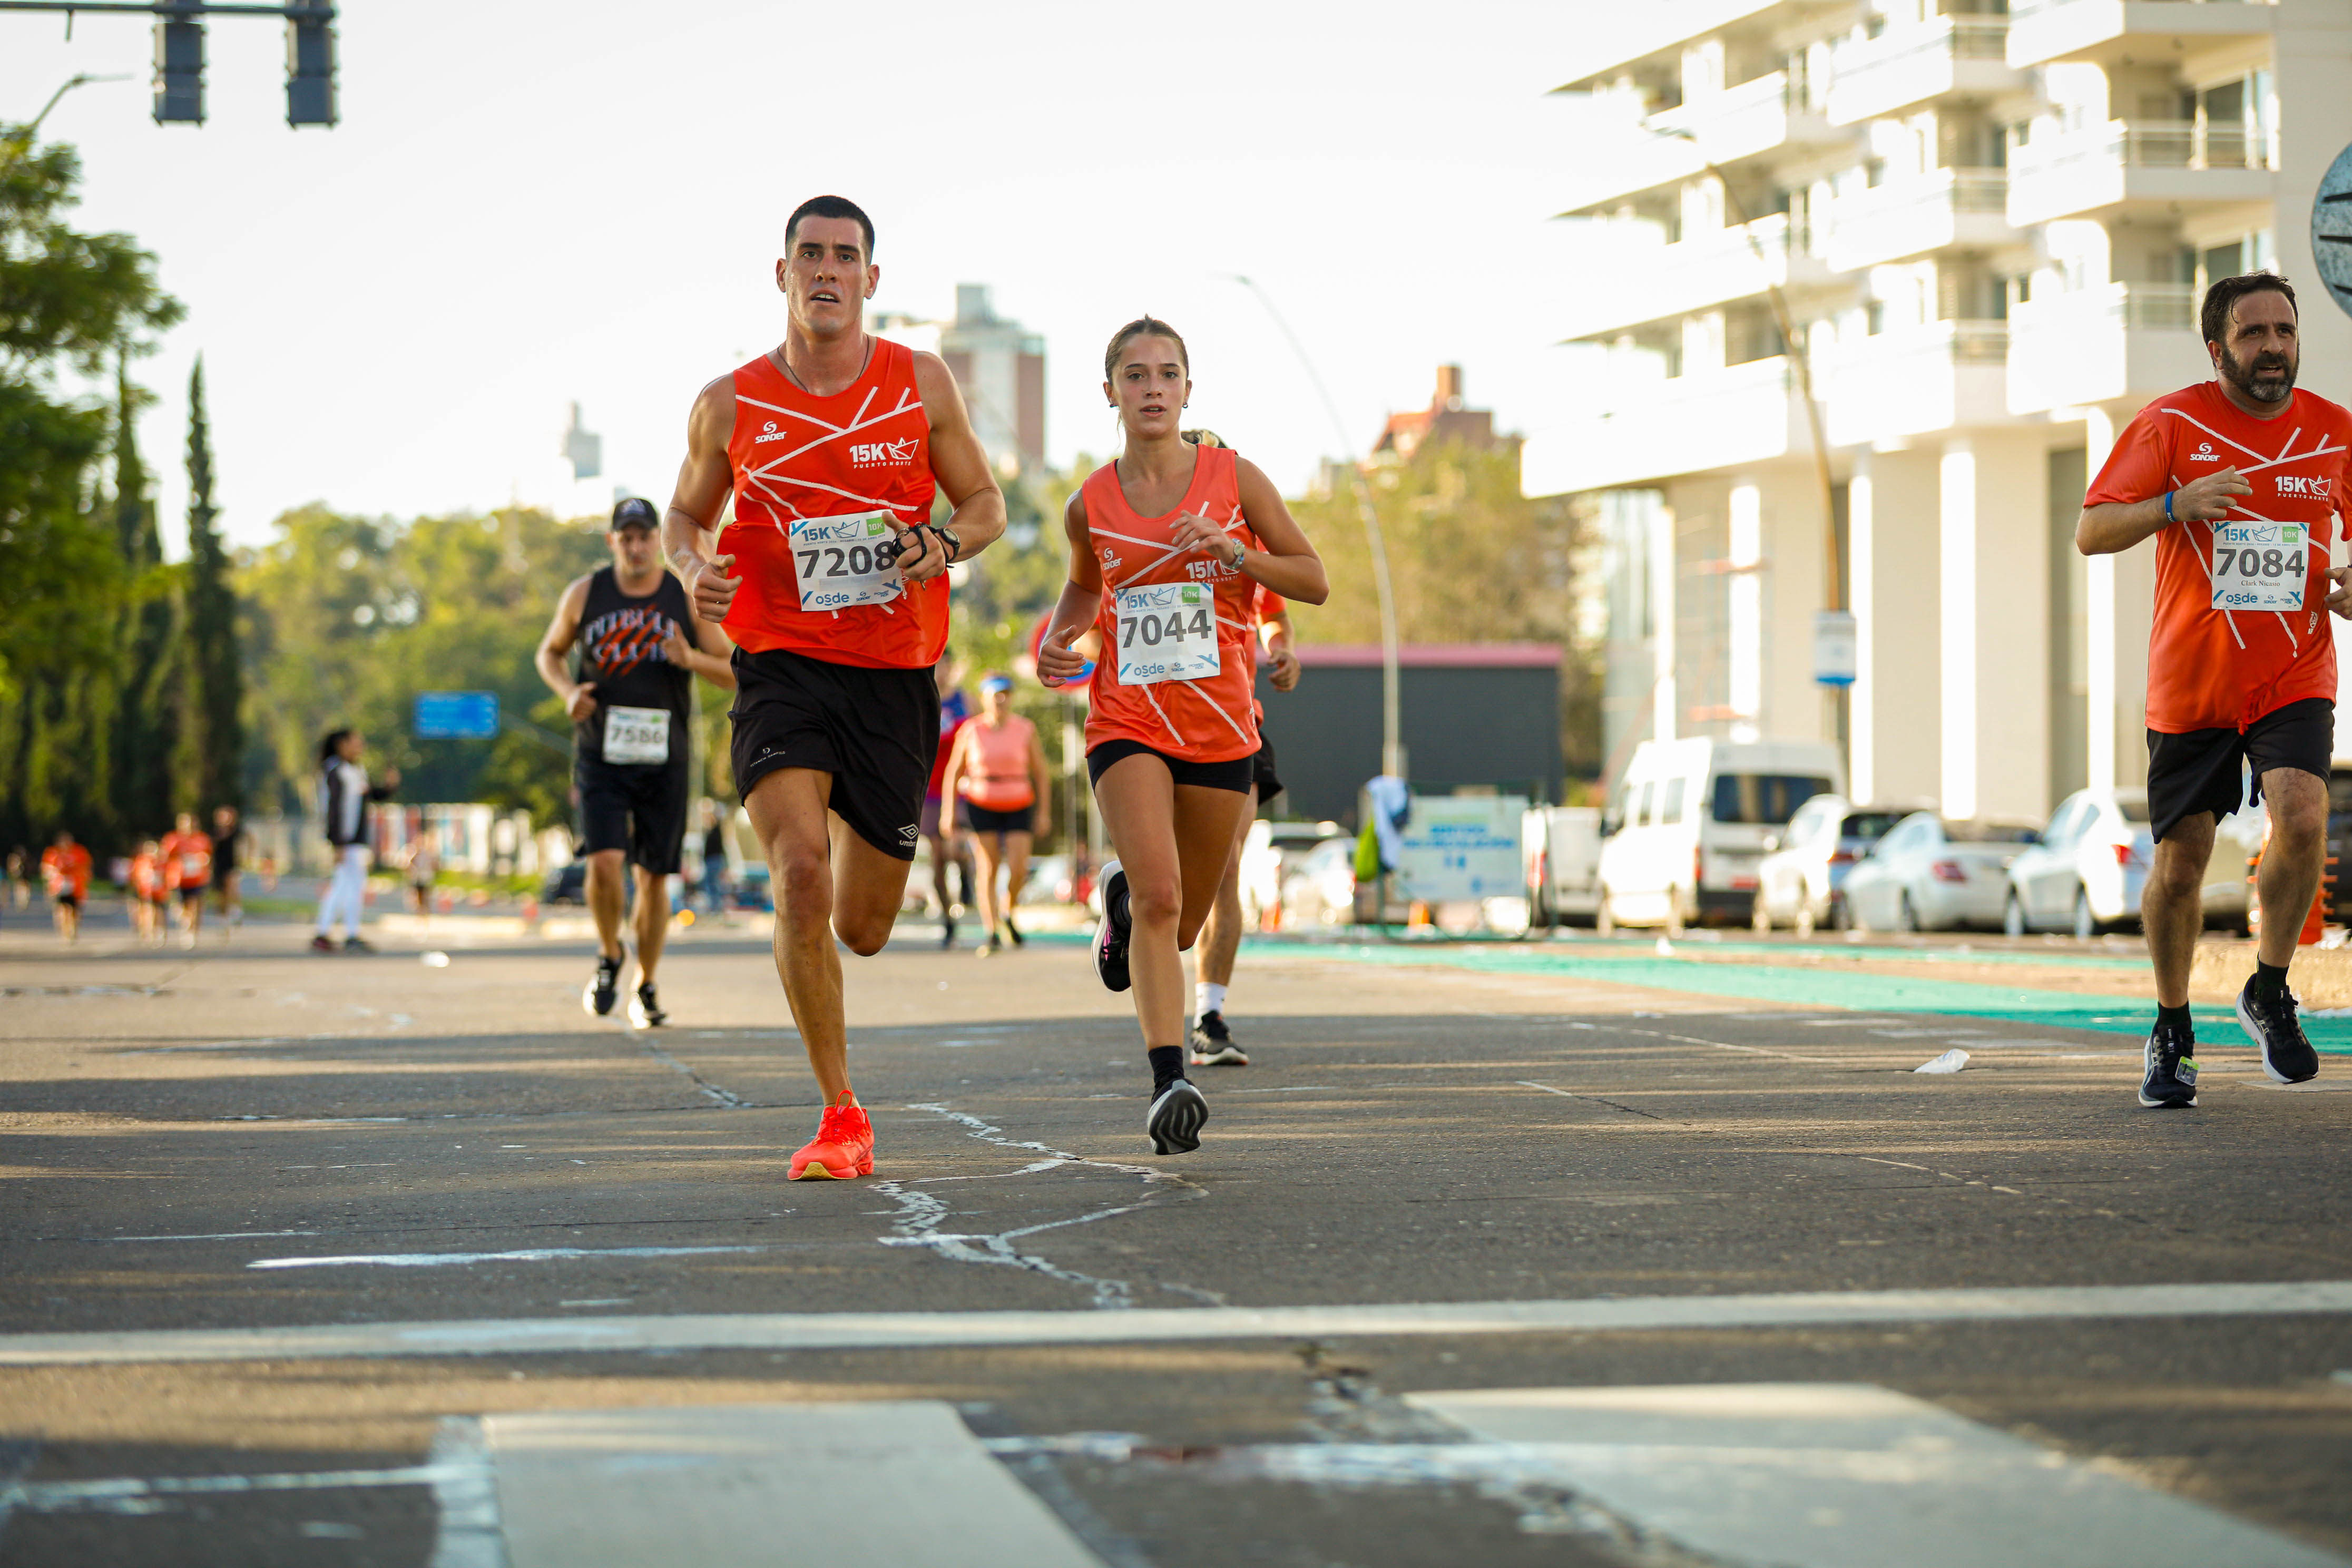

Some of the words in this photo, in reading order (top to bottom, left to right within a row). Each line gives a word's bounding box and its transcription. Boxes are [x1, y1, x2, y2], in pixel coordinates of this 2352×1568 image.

[849, 443, 886, 463] 15K
[2275, 476, 2307, 493] 15K
[801, 526, 831, 542] 15K
[869, 522, 883, 531] 10K
[2223, 528, 2250, 541] 15K
[797, 541, 896, 578] 7208
[2217, 548, 2305, 577] 7084
[1185, 560, 1218, 579] 15K
[815, 592, 849, 605] osde
[1125, 593, 1149, 609] 15K
[2226, 592, 2258, 604] osde
[1121, 609, 1212, 648] 7044
[1134, 662, 1165, 677] osde
